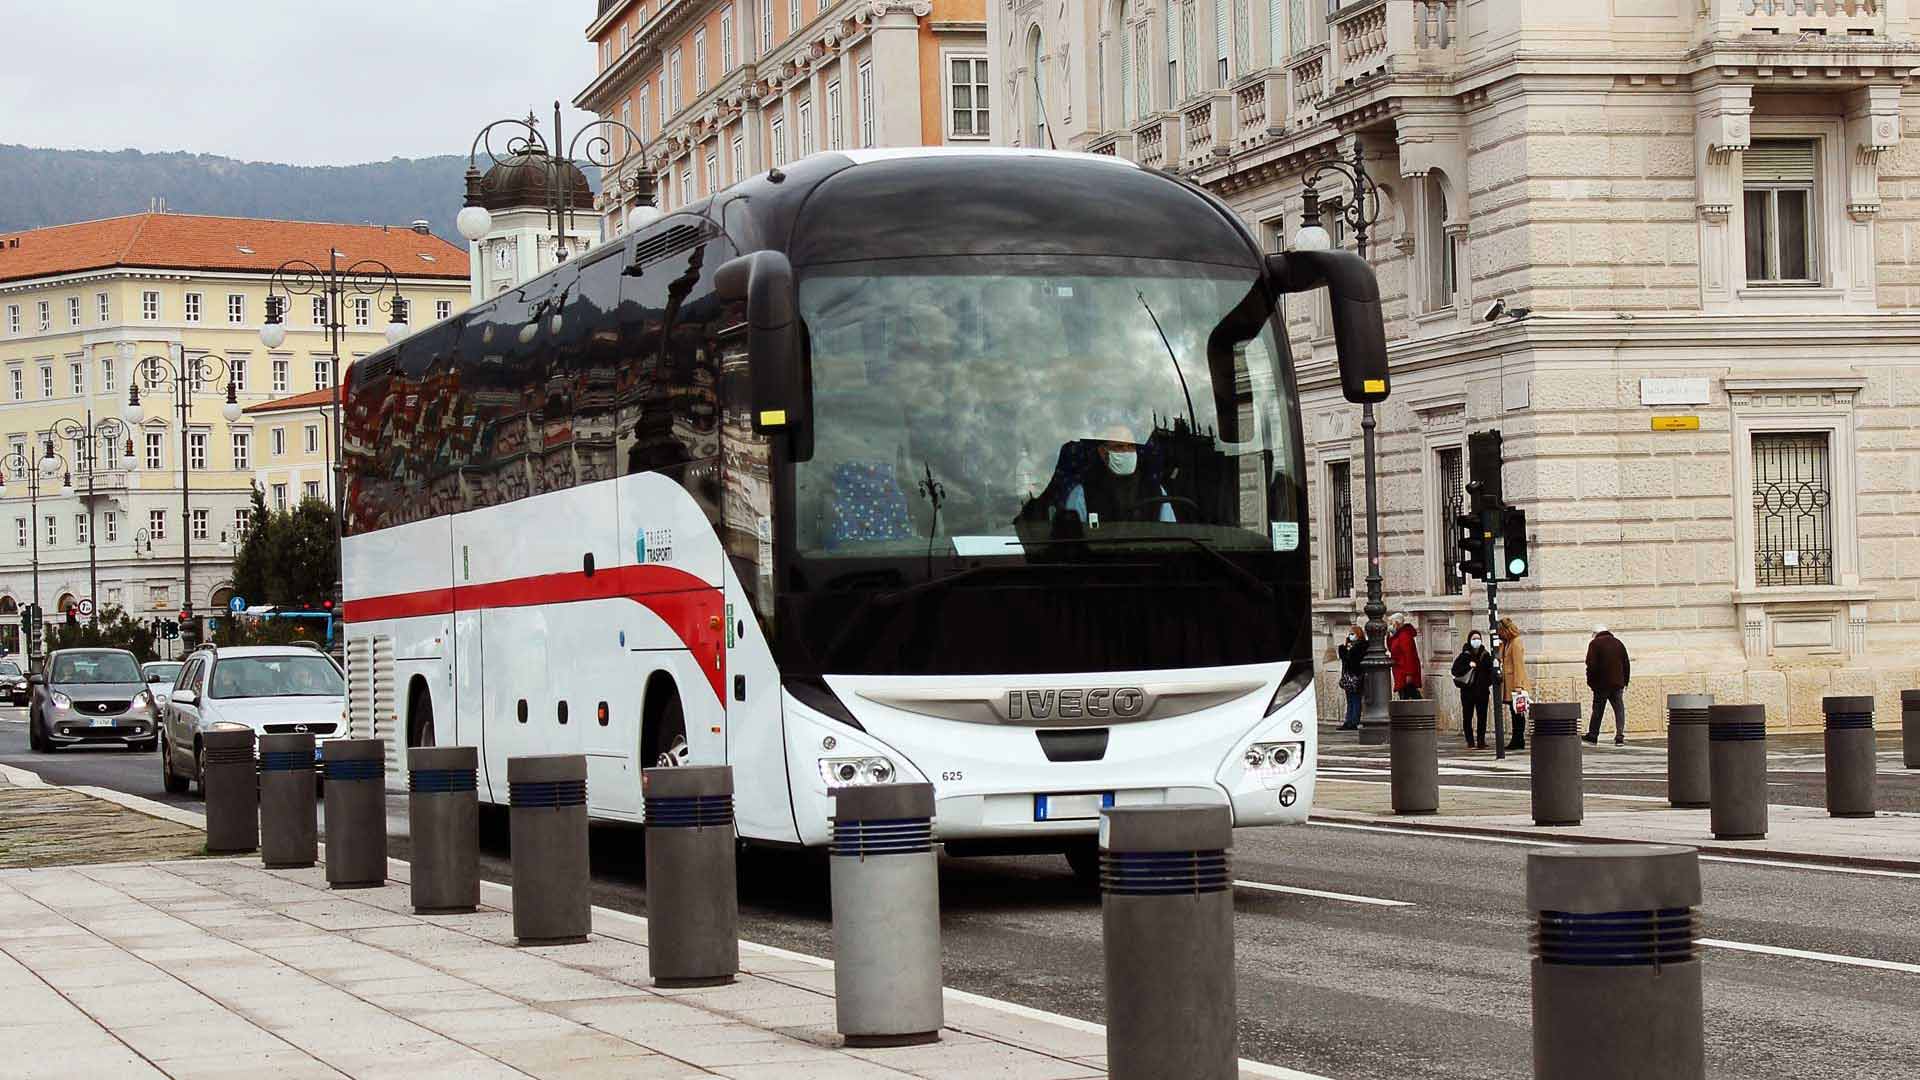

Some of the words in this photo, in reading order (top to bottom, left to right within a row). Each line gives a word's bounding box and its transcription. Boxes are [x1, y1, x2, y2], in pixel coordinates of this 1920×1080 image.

[647, 547, 672, 562] TRASPORTI
[1009, 687, 1143, 719] IVECO
[942, 771, 963, 781] 625
